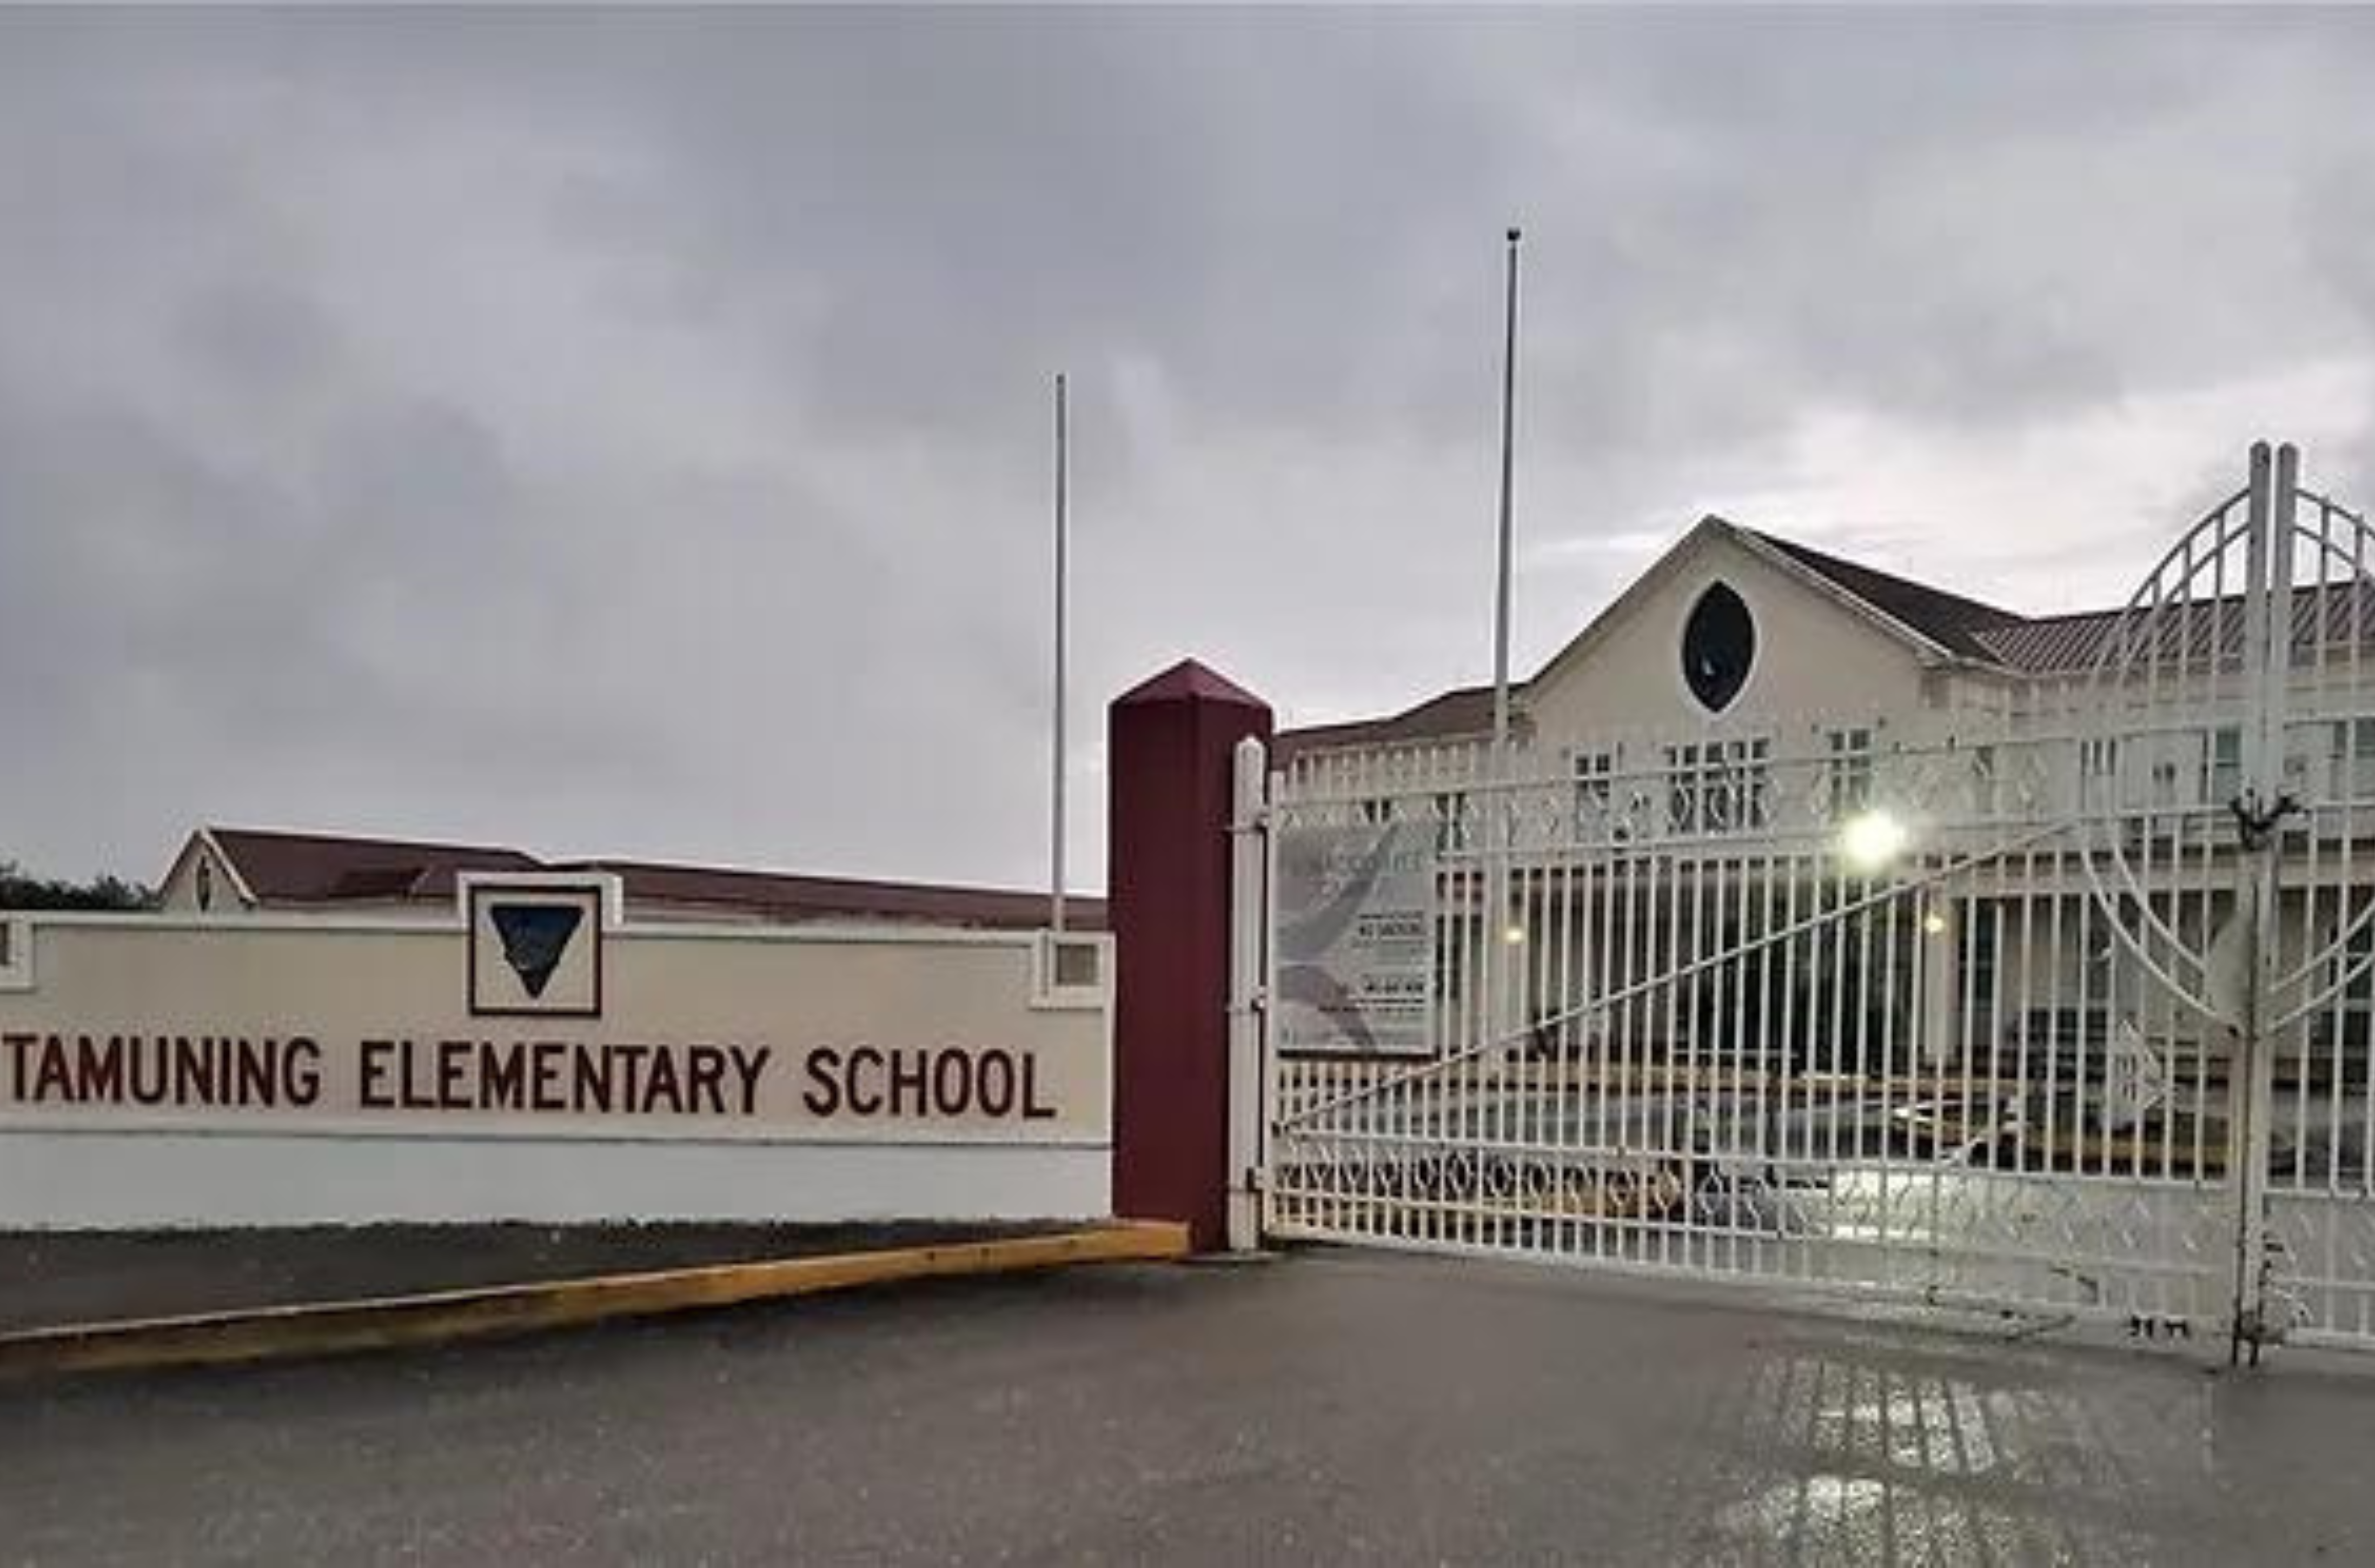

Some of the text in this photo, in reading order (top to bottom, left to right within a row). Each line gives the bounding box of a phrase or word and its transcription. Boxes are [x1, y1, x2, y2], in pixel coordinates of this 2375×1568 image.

[2, 1033, 1057, 1120] TAMUNING ELEMENTARY SCHOOL
